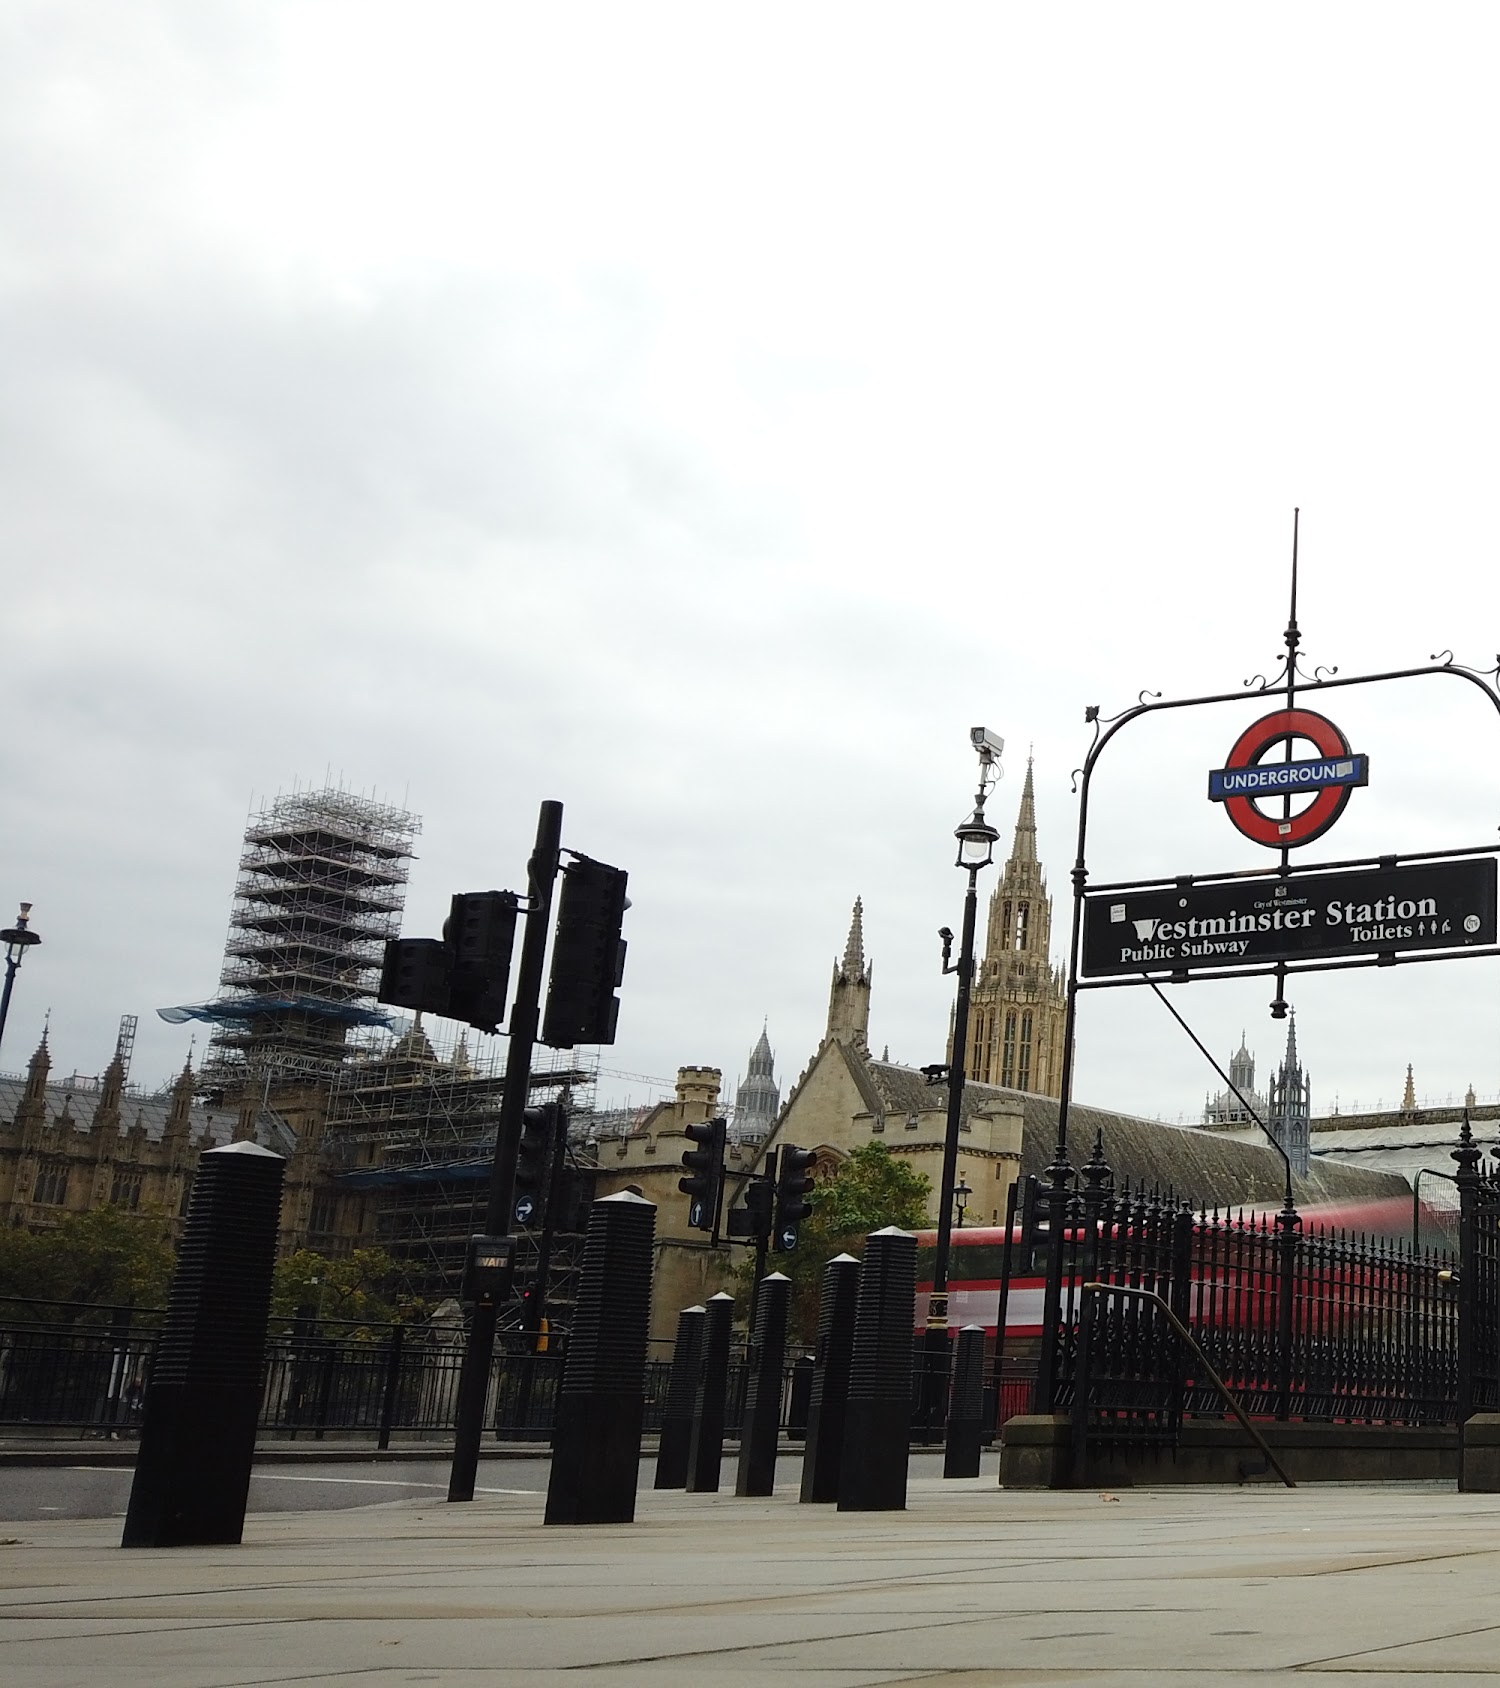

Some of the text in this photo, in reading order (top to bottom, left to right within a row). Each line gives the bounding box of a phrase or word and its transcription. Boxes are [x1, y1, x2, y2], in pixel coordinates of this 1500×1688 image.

[1326, 895, 1437, 926] Station
[1350, 923, 1413, 942] Toilets
[1120, 939, 1249, 962] Public Subway
